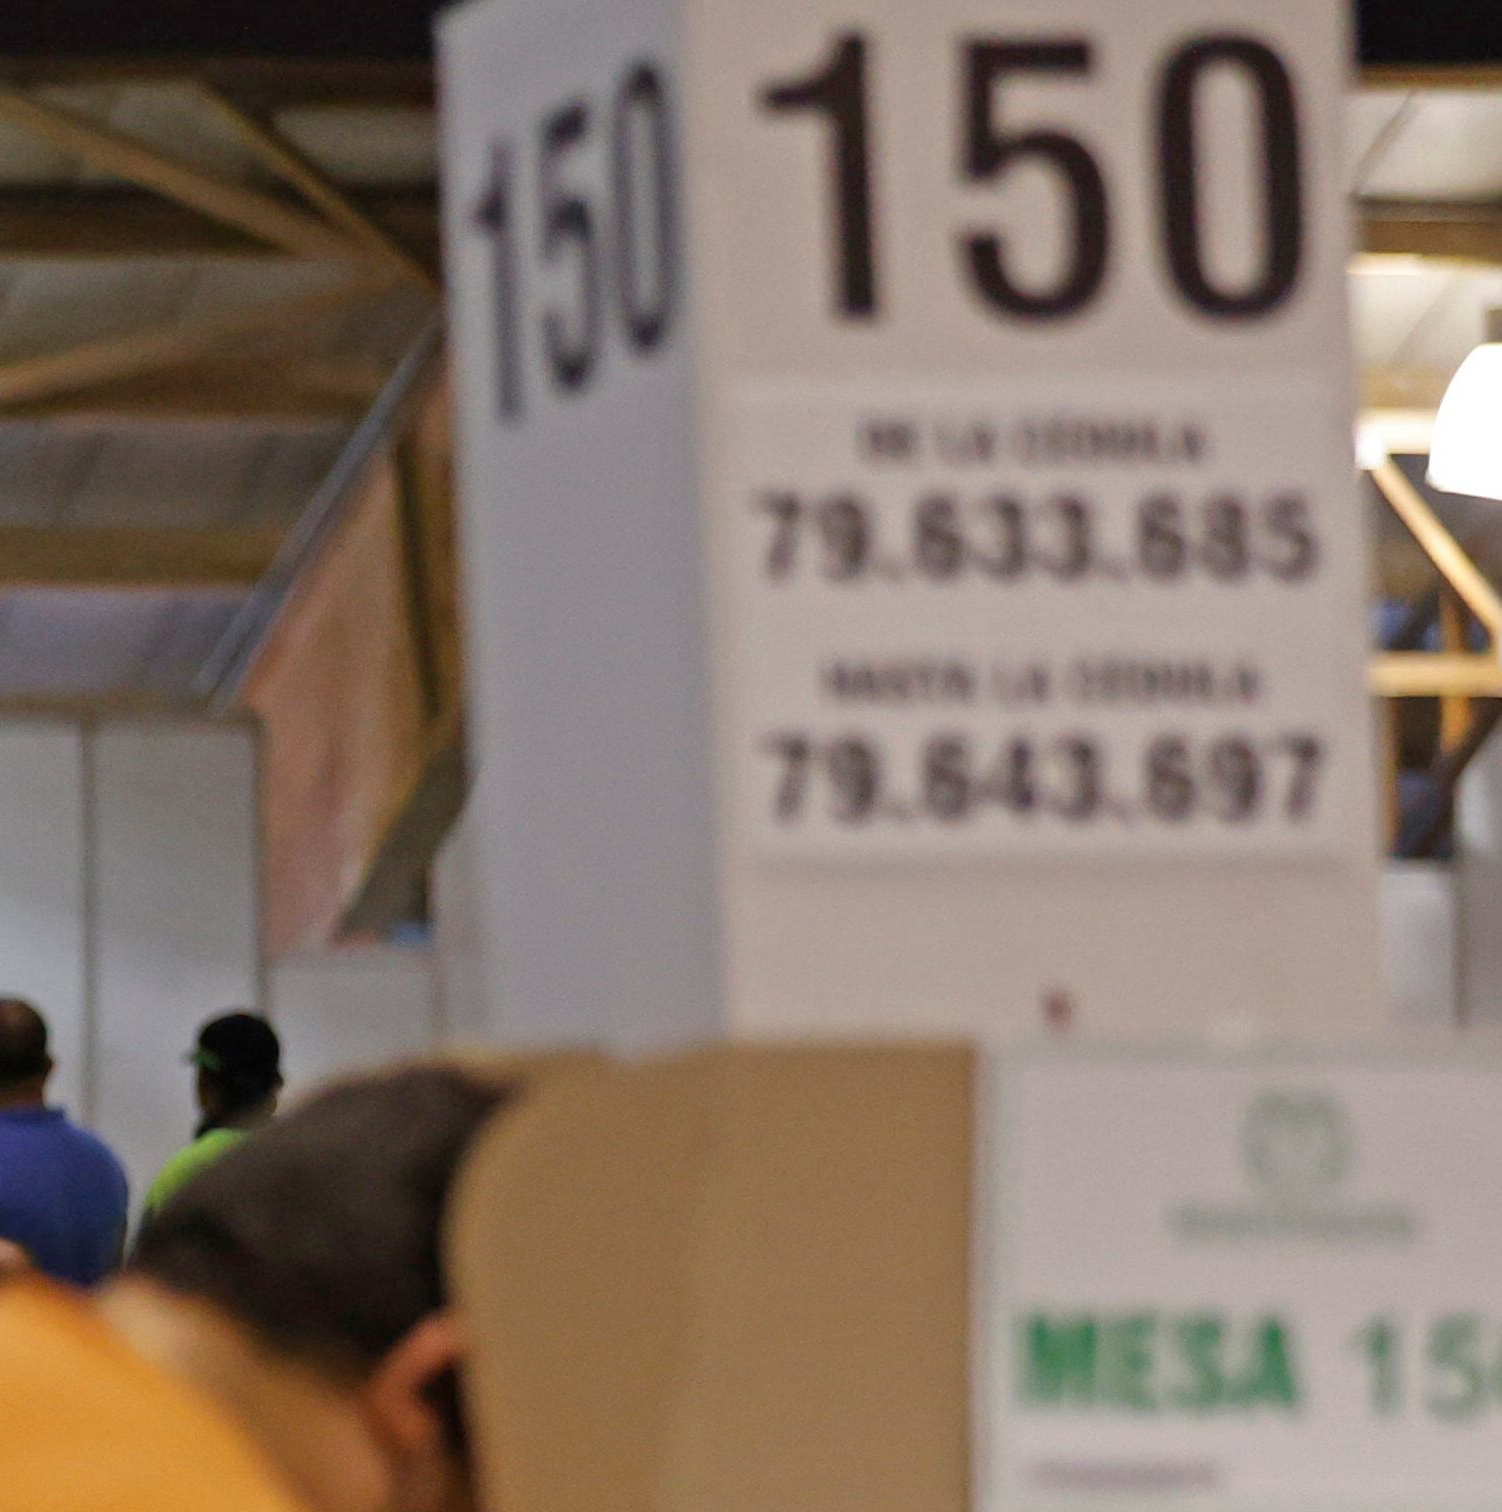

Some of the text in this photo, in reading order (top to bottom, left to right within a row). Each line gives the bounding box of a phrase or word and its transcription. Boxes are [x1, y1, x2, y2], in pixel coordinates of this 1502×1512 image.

[759, 28, 1308, 328] 150
[470, 56, 680, 420] 150
[762, 490, 1321, 585] 79.633.685
[769, 732, 1328, 824] 79.643.697
[1018, 1310, 1301, 1412] MESA
